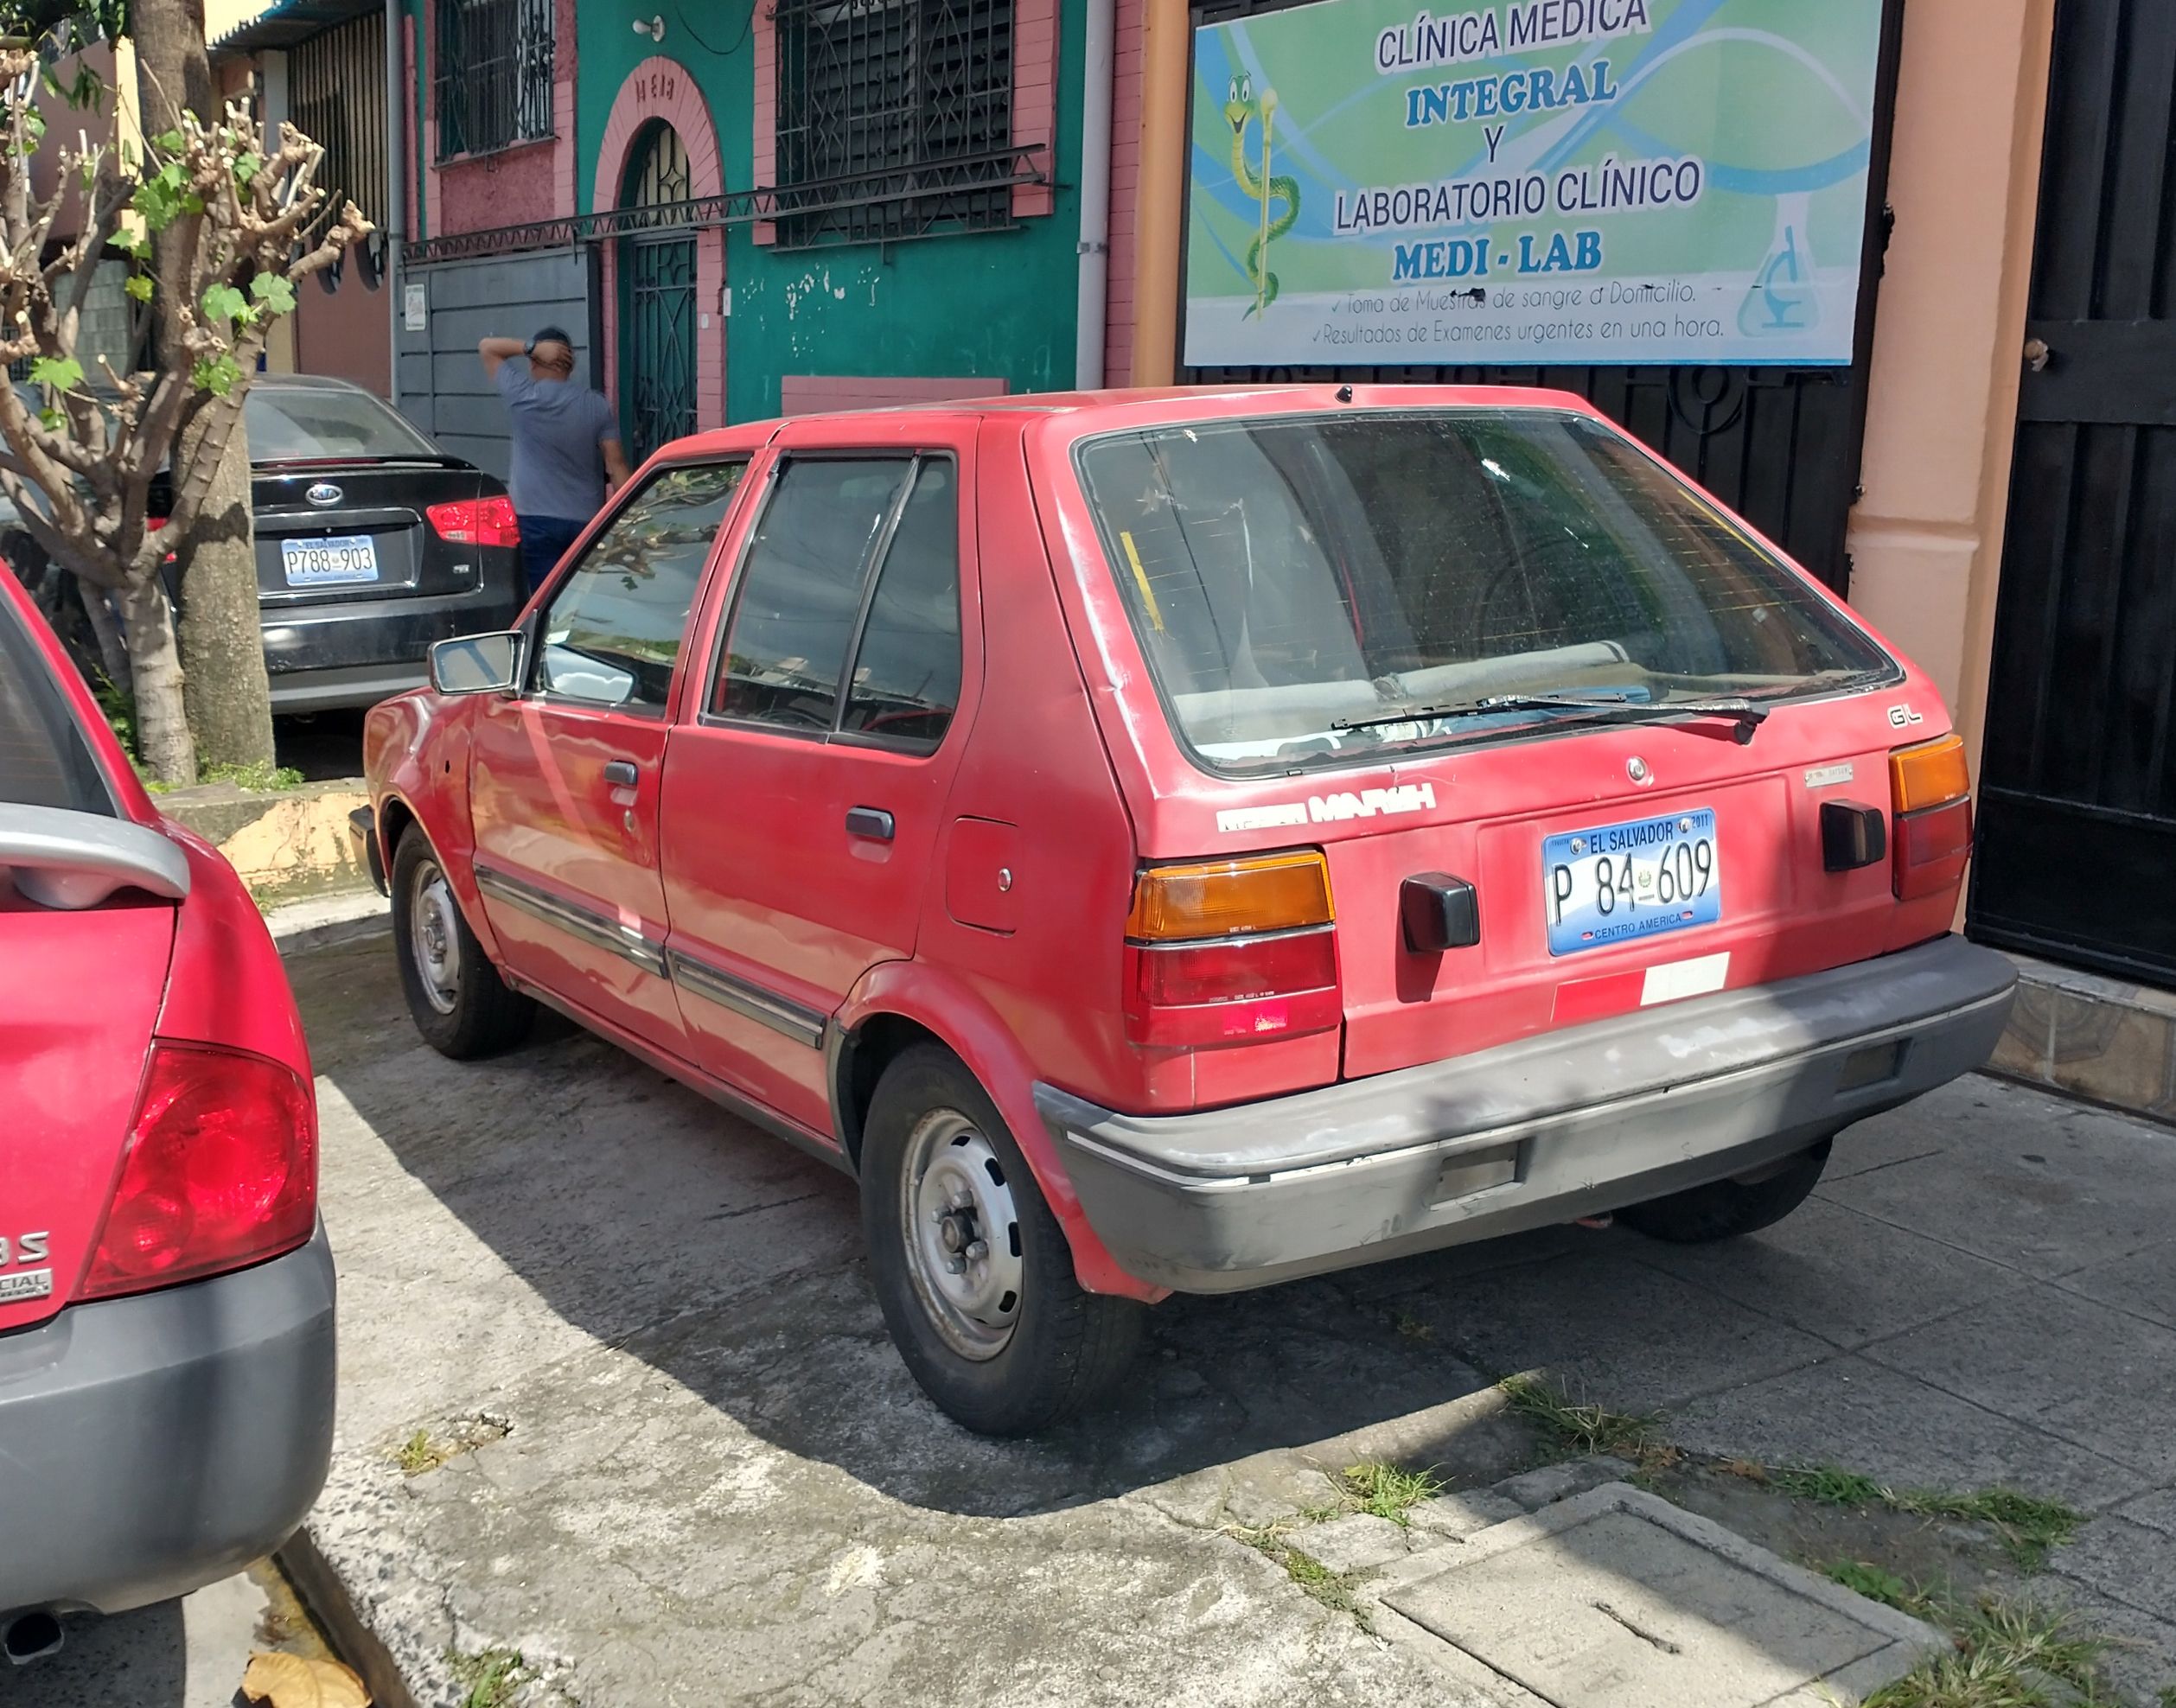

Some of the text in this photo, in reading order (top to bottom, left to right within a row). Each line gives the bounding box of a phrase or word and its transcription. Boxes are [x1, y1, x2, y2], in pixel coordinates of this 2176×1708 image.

[1379, 13, 1498, 68] CLÍNICA
[1406, 61, 1618, 126] INTEGRAL
[1484, 124, 1504, 163] Y
[1337, 159, 1700, 230] LABORATORIO CLÍNICO
[1393, 239, 1490, 280] MEDI
[1517, 232, 1602, 273] LAB
[1347, 293, 1383, 314] Toma
[1390, 291, 1409, 312] de
[1416, 290, 1486, 311] Muestras
[1493, 286, 1515, 308] de
[1522, 289, 1582, 309] sangre
[1324, 314, 1724, 344] Resultados de Examenes urgentes en una hora.
[1888, 705, 1922, 728] GL
[1590, 814, 1709, 854] EL SALVADOR 2011
[1553, 864, 1573, 927] P
[1594, 913, 1682, 940] CENTRO AMERICA
